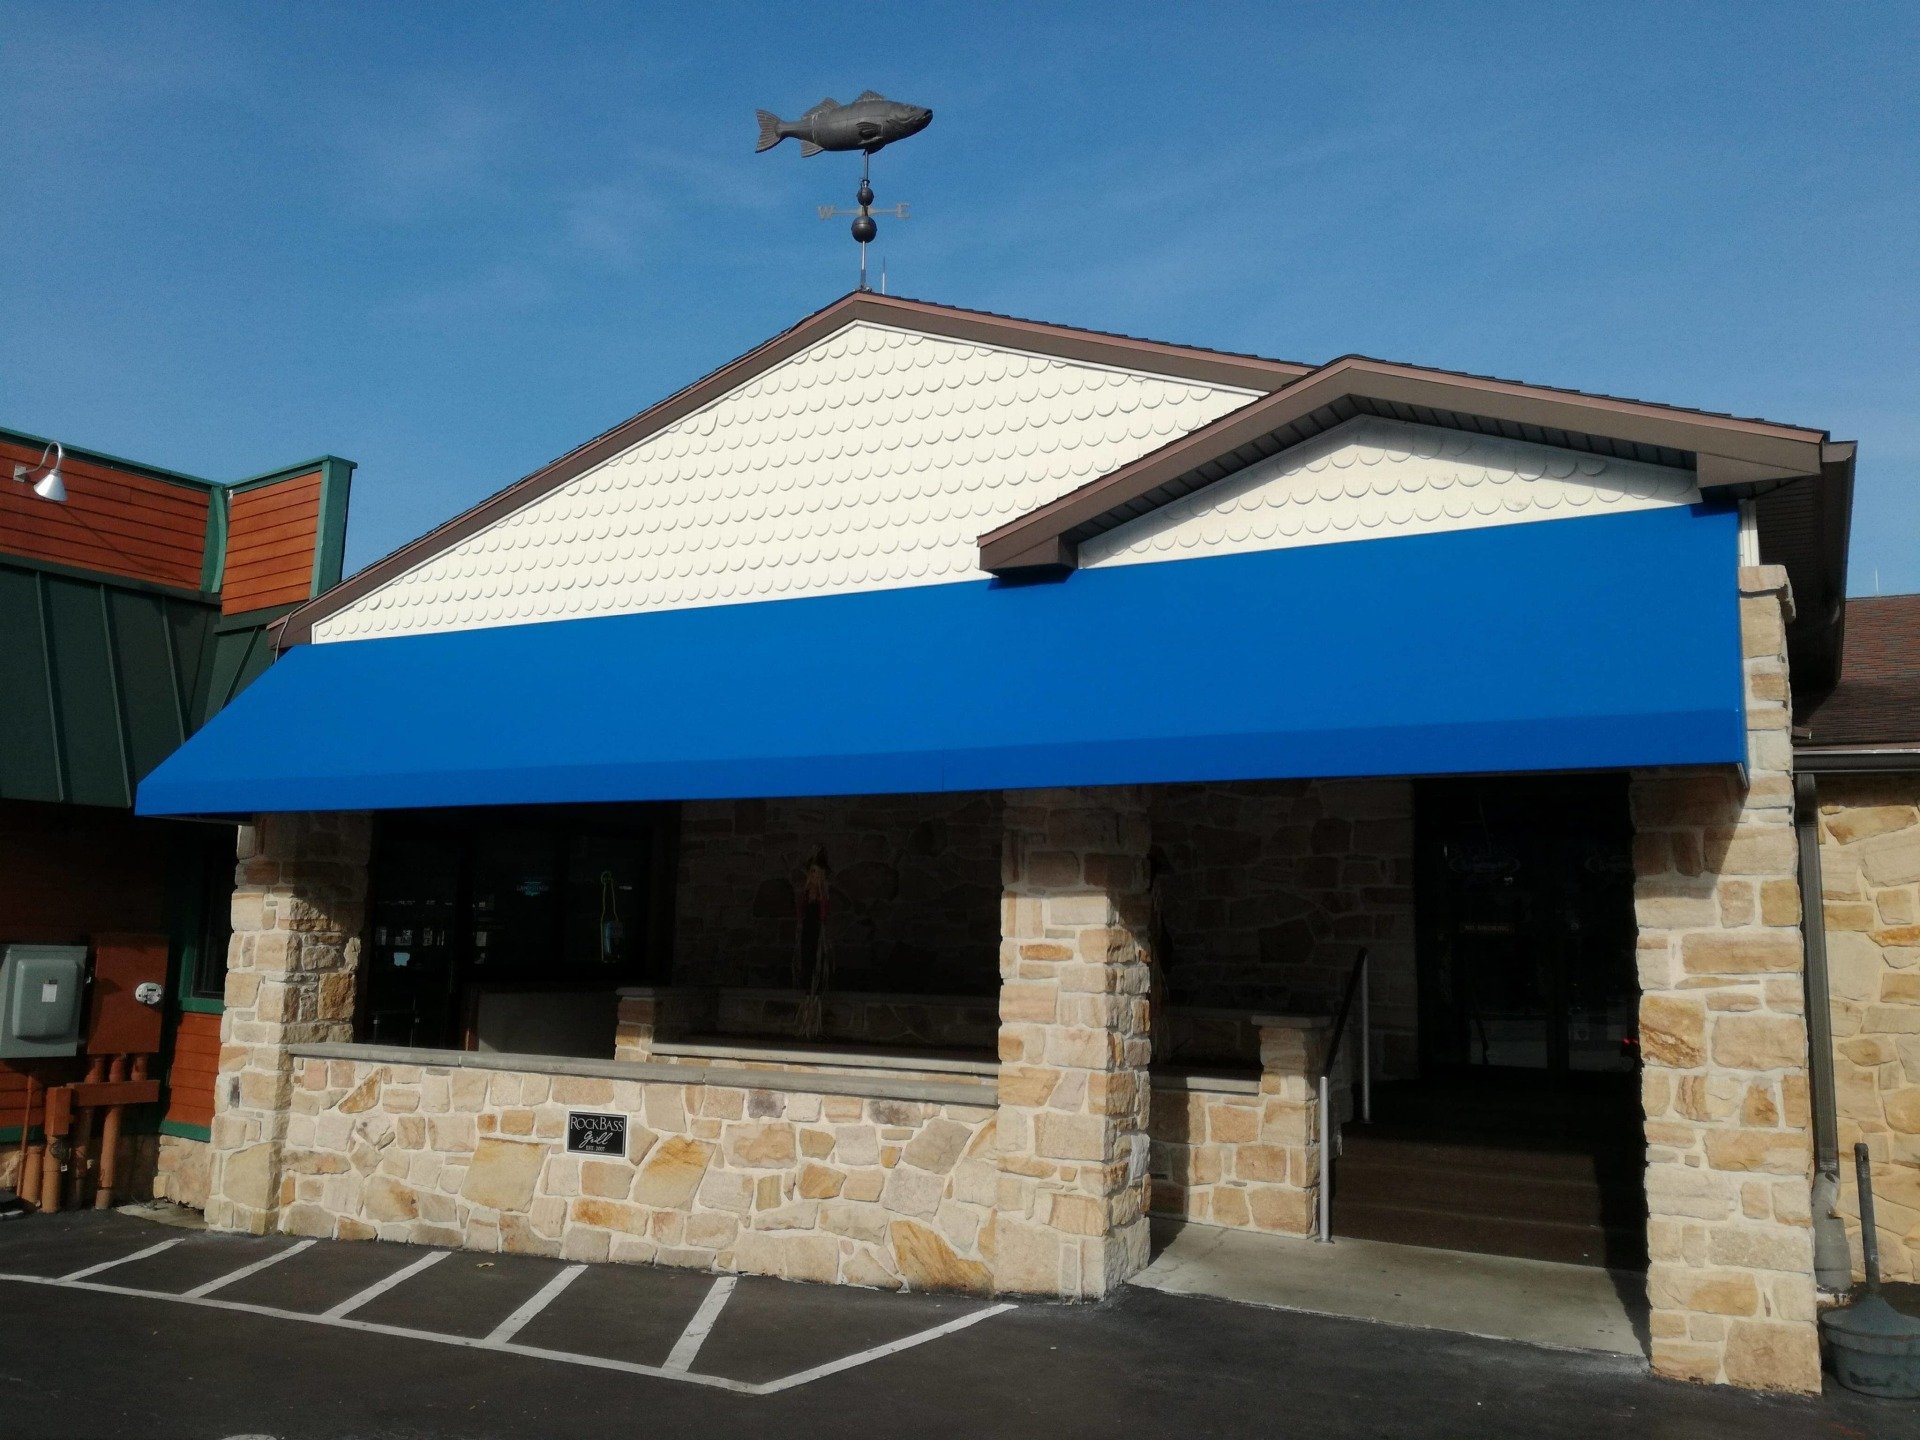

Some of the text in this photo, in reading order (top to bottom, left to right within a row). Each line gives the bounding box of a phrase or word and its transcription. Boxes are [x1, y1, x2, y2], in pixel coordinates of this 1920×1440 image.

[896, 203, 911, 219] E
[570, 1116, 624, 1132] ROCK BASS
